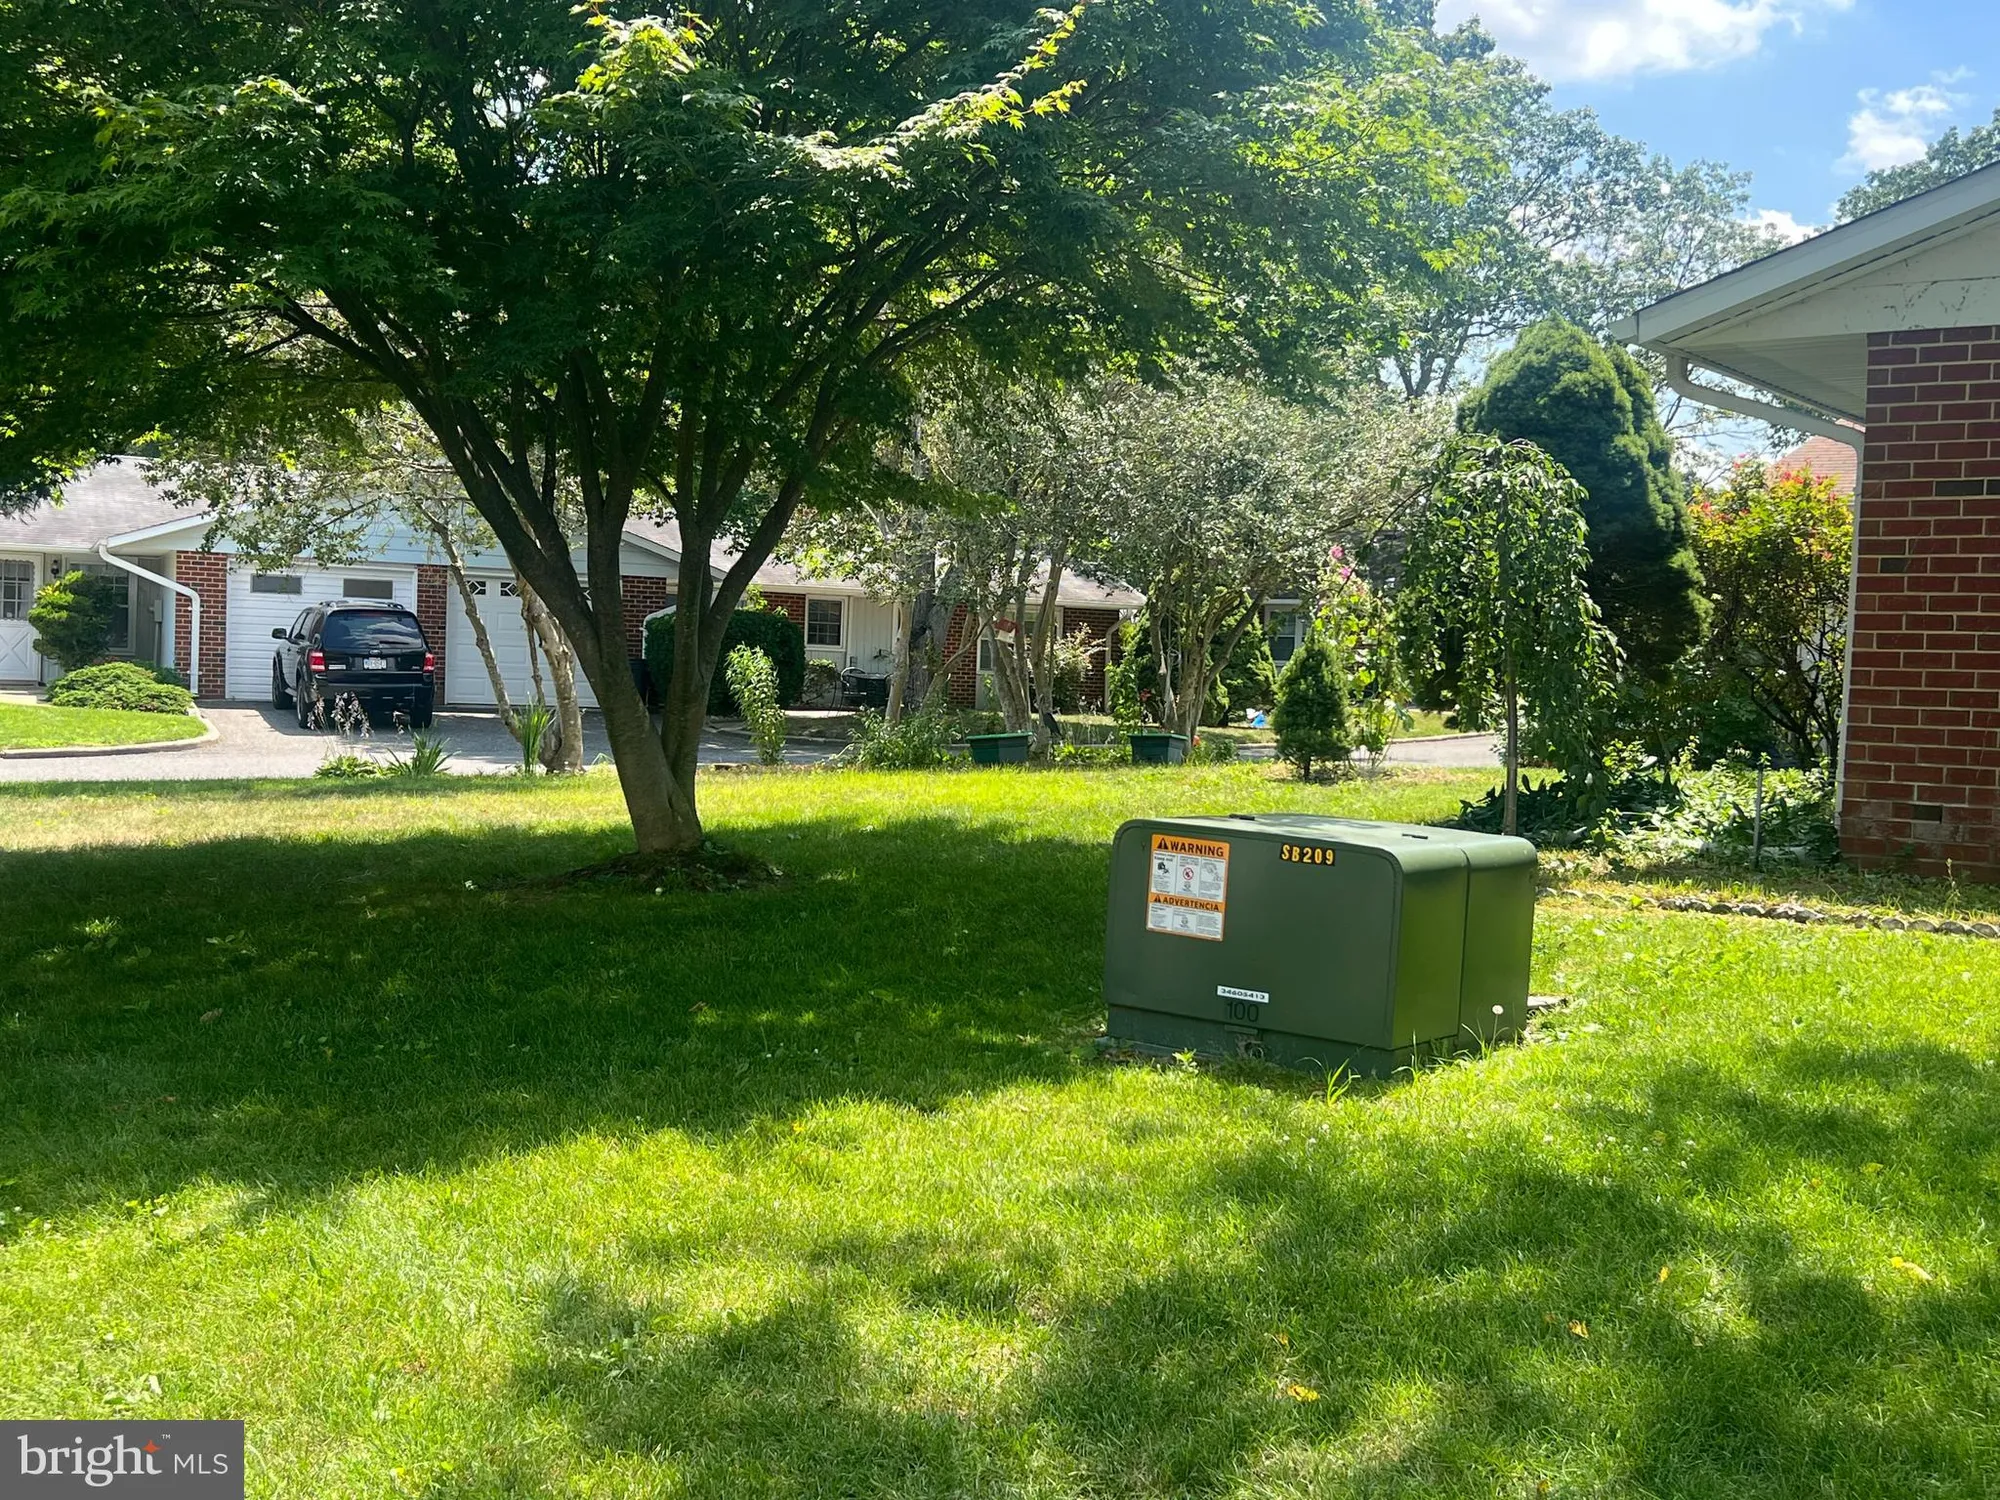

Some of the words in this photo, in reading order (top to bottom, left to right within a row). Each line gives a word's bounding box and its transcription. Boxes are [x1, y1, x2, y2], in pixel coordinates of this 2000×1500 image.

[1170, 841, 1224, 857] WARNING
[1281, 844, 1334, 865] SB209
[1163, 896, 1220, 911] ADVERTENCIA
[1227, 1001, 1259, 1022] 100
